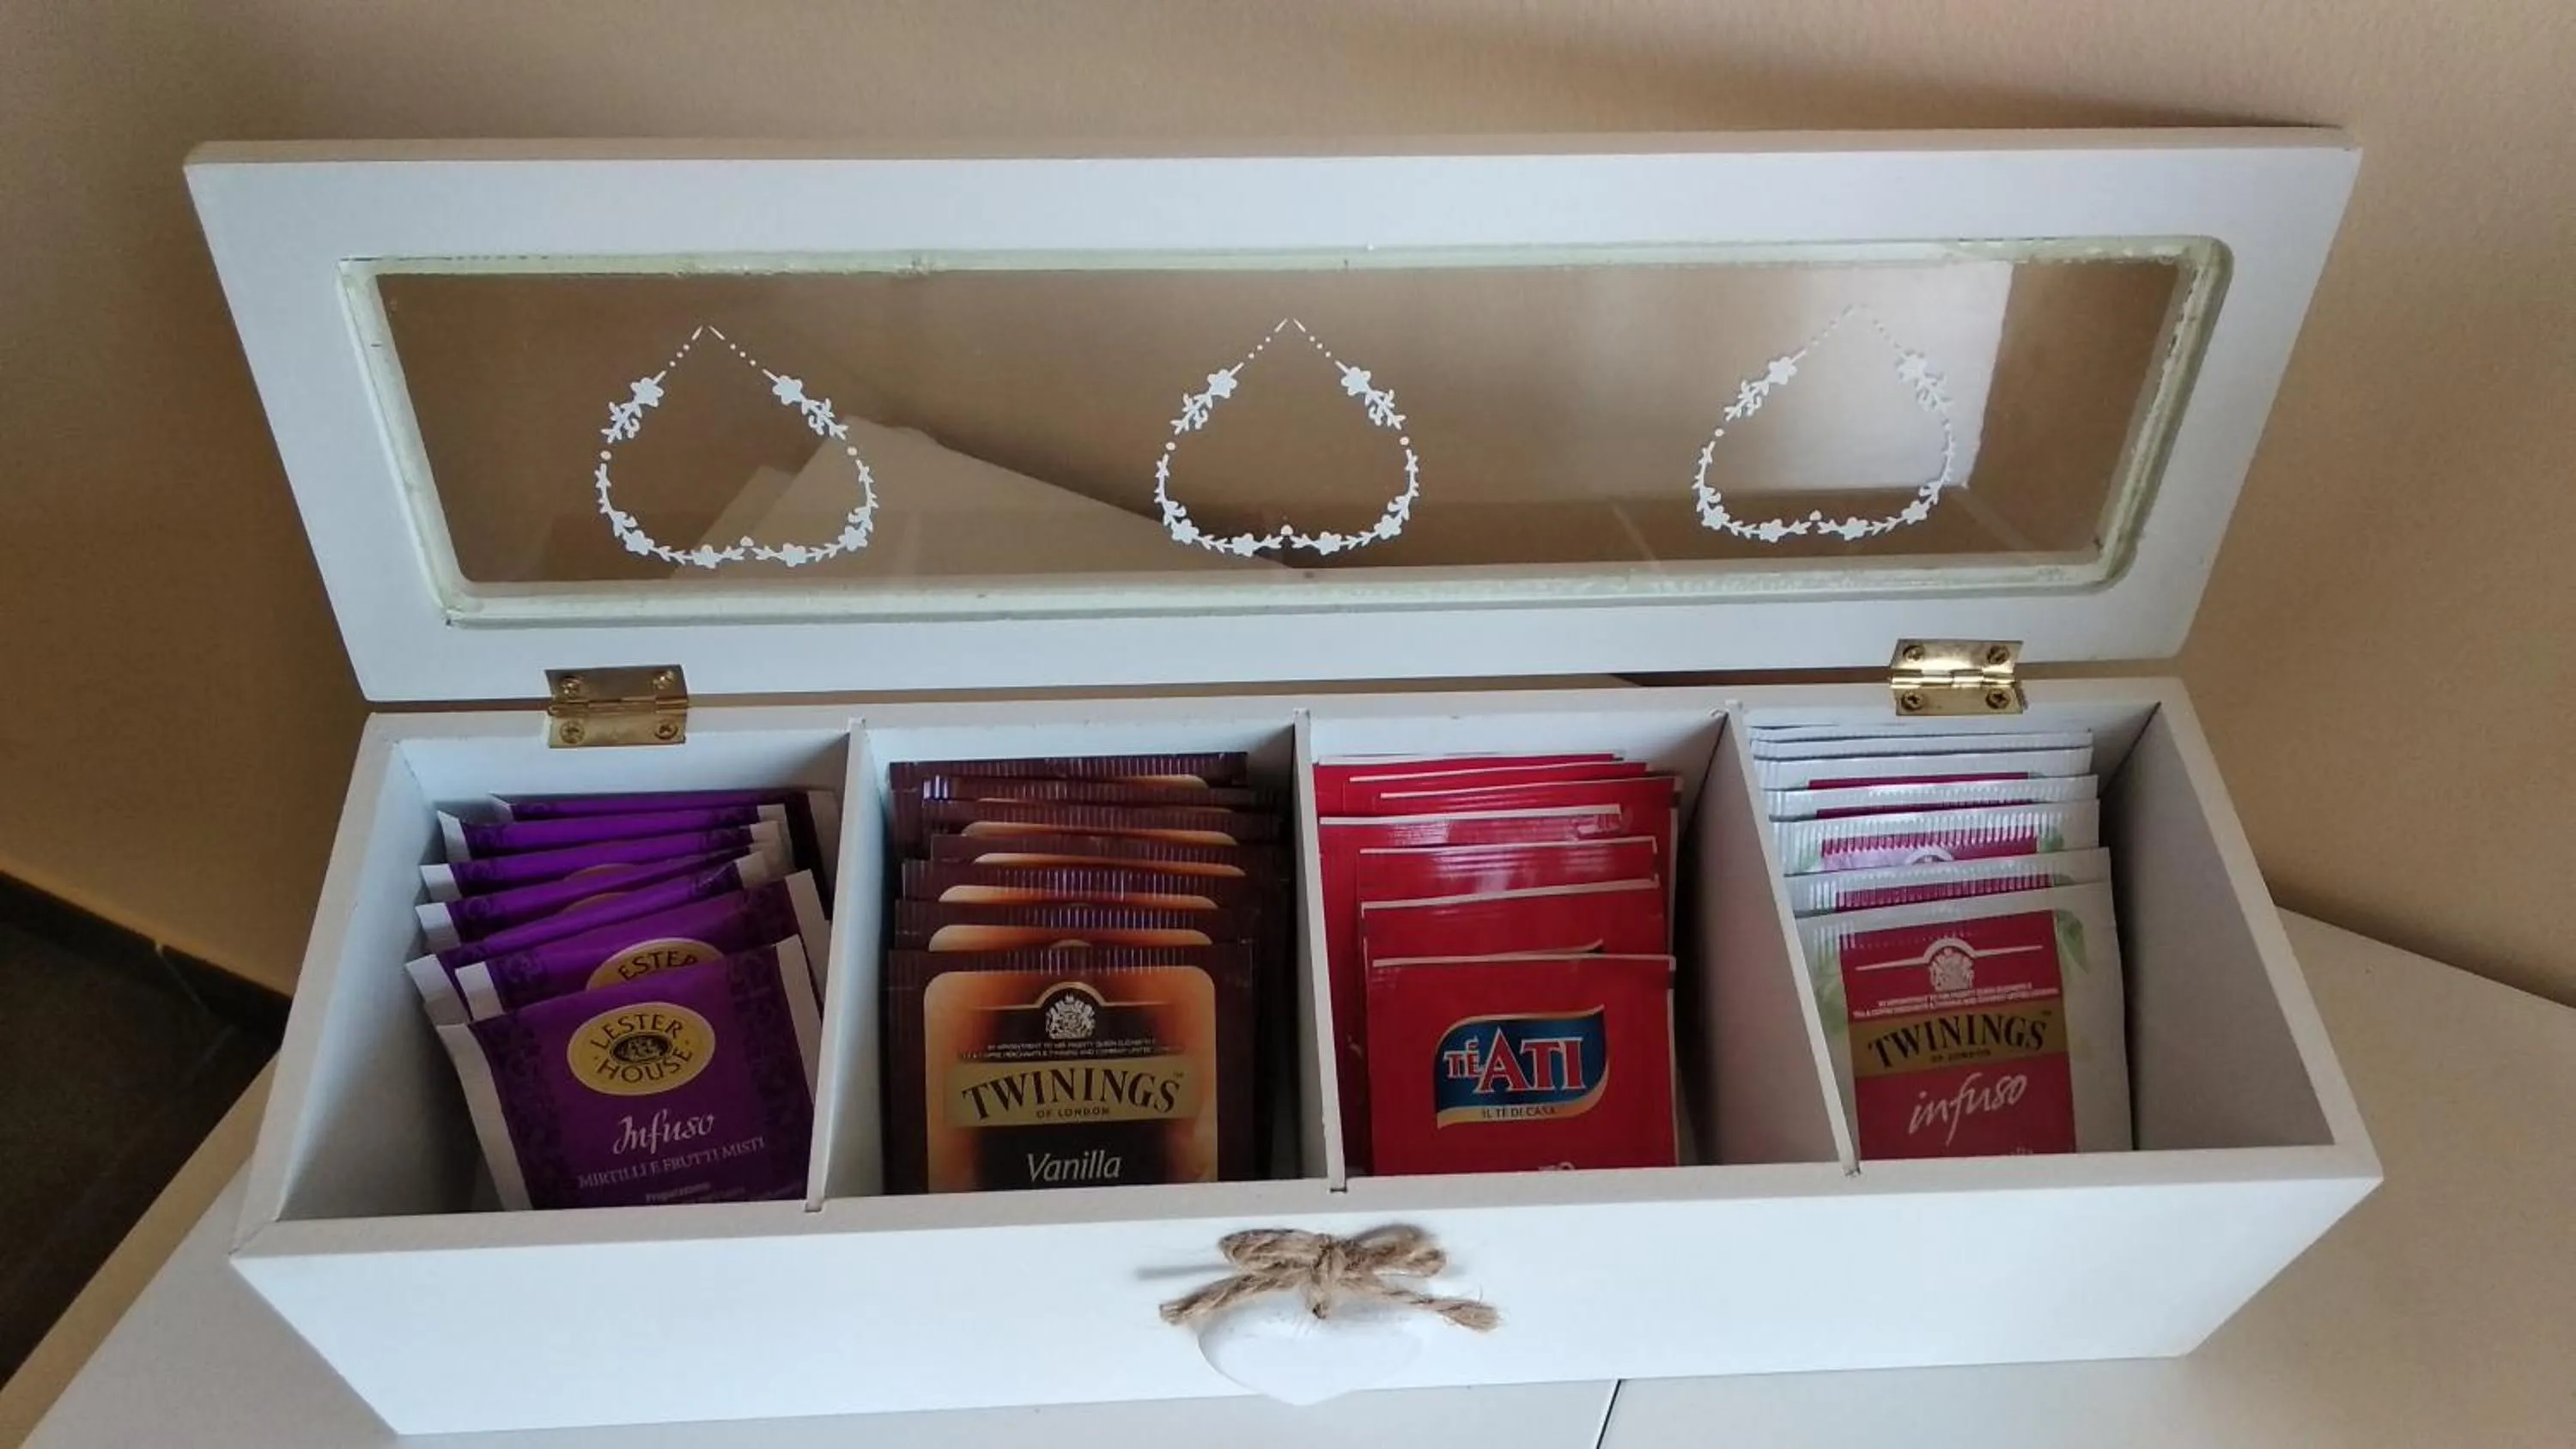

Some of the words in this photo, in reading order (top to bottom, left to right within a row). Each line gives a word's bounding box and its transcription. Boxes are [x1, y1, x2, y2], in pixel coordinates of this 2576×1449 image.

[591, 1014, 683, 1051] LESTER
[1868, 1014, 2047, 1069] TWININGS
[597, 1046, 693, 1083] HOUSE
[1473, 1026, 1587, 1094] ATI
[962, 1067, 1181, 1120] TWININGS
[1057, 1105, 1110, 1119] LONDON
[1907, 1072, 2027, 1148] infuso
[612, 1109, 714, 1154] Infuso
[578, 1161, 647, 1189] MIRTILLI
[663, 1148, 718, 1173] FRUTTI
[721, 1136, 766, 1158] MISTI
[1027, 1149, 1122, 1183] Vanilla
